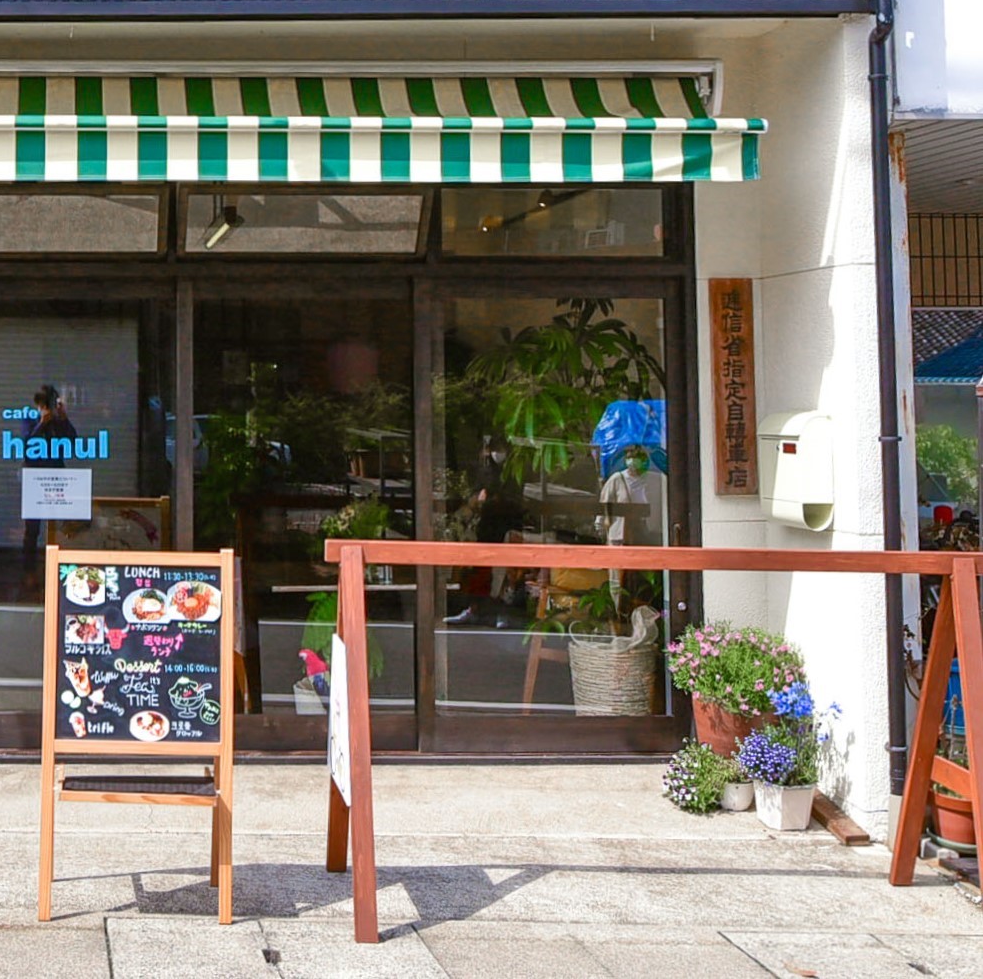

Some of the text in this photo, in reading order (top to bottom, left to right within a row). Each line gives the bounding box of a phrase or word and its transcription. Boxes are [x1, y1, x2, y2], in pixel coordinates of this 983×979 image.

[2, 430, 108, 459] hanul
[124, 566, 160, 578] LUNCH
[126, 693, 159, 707] TIME
